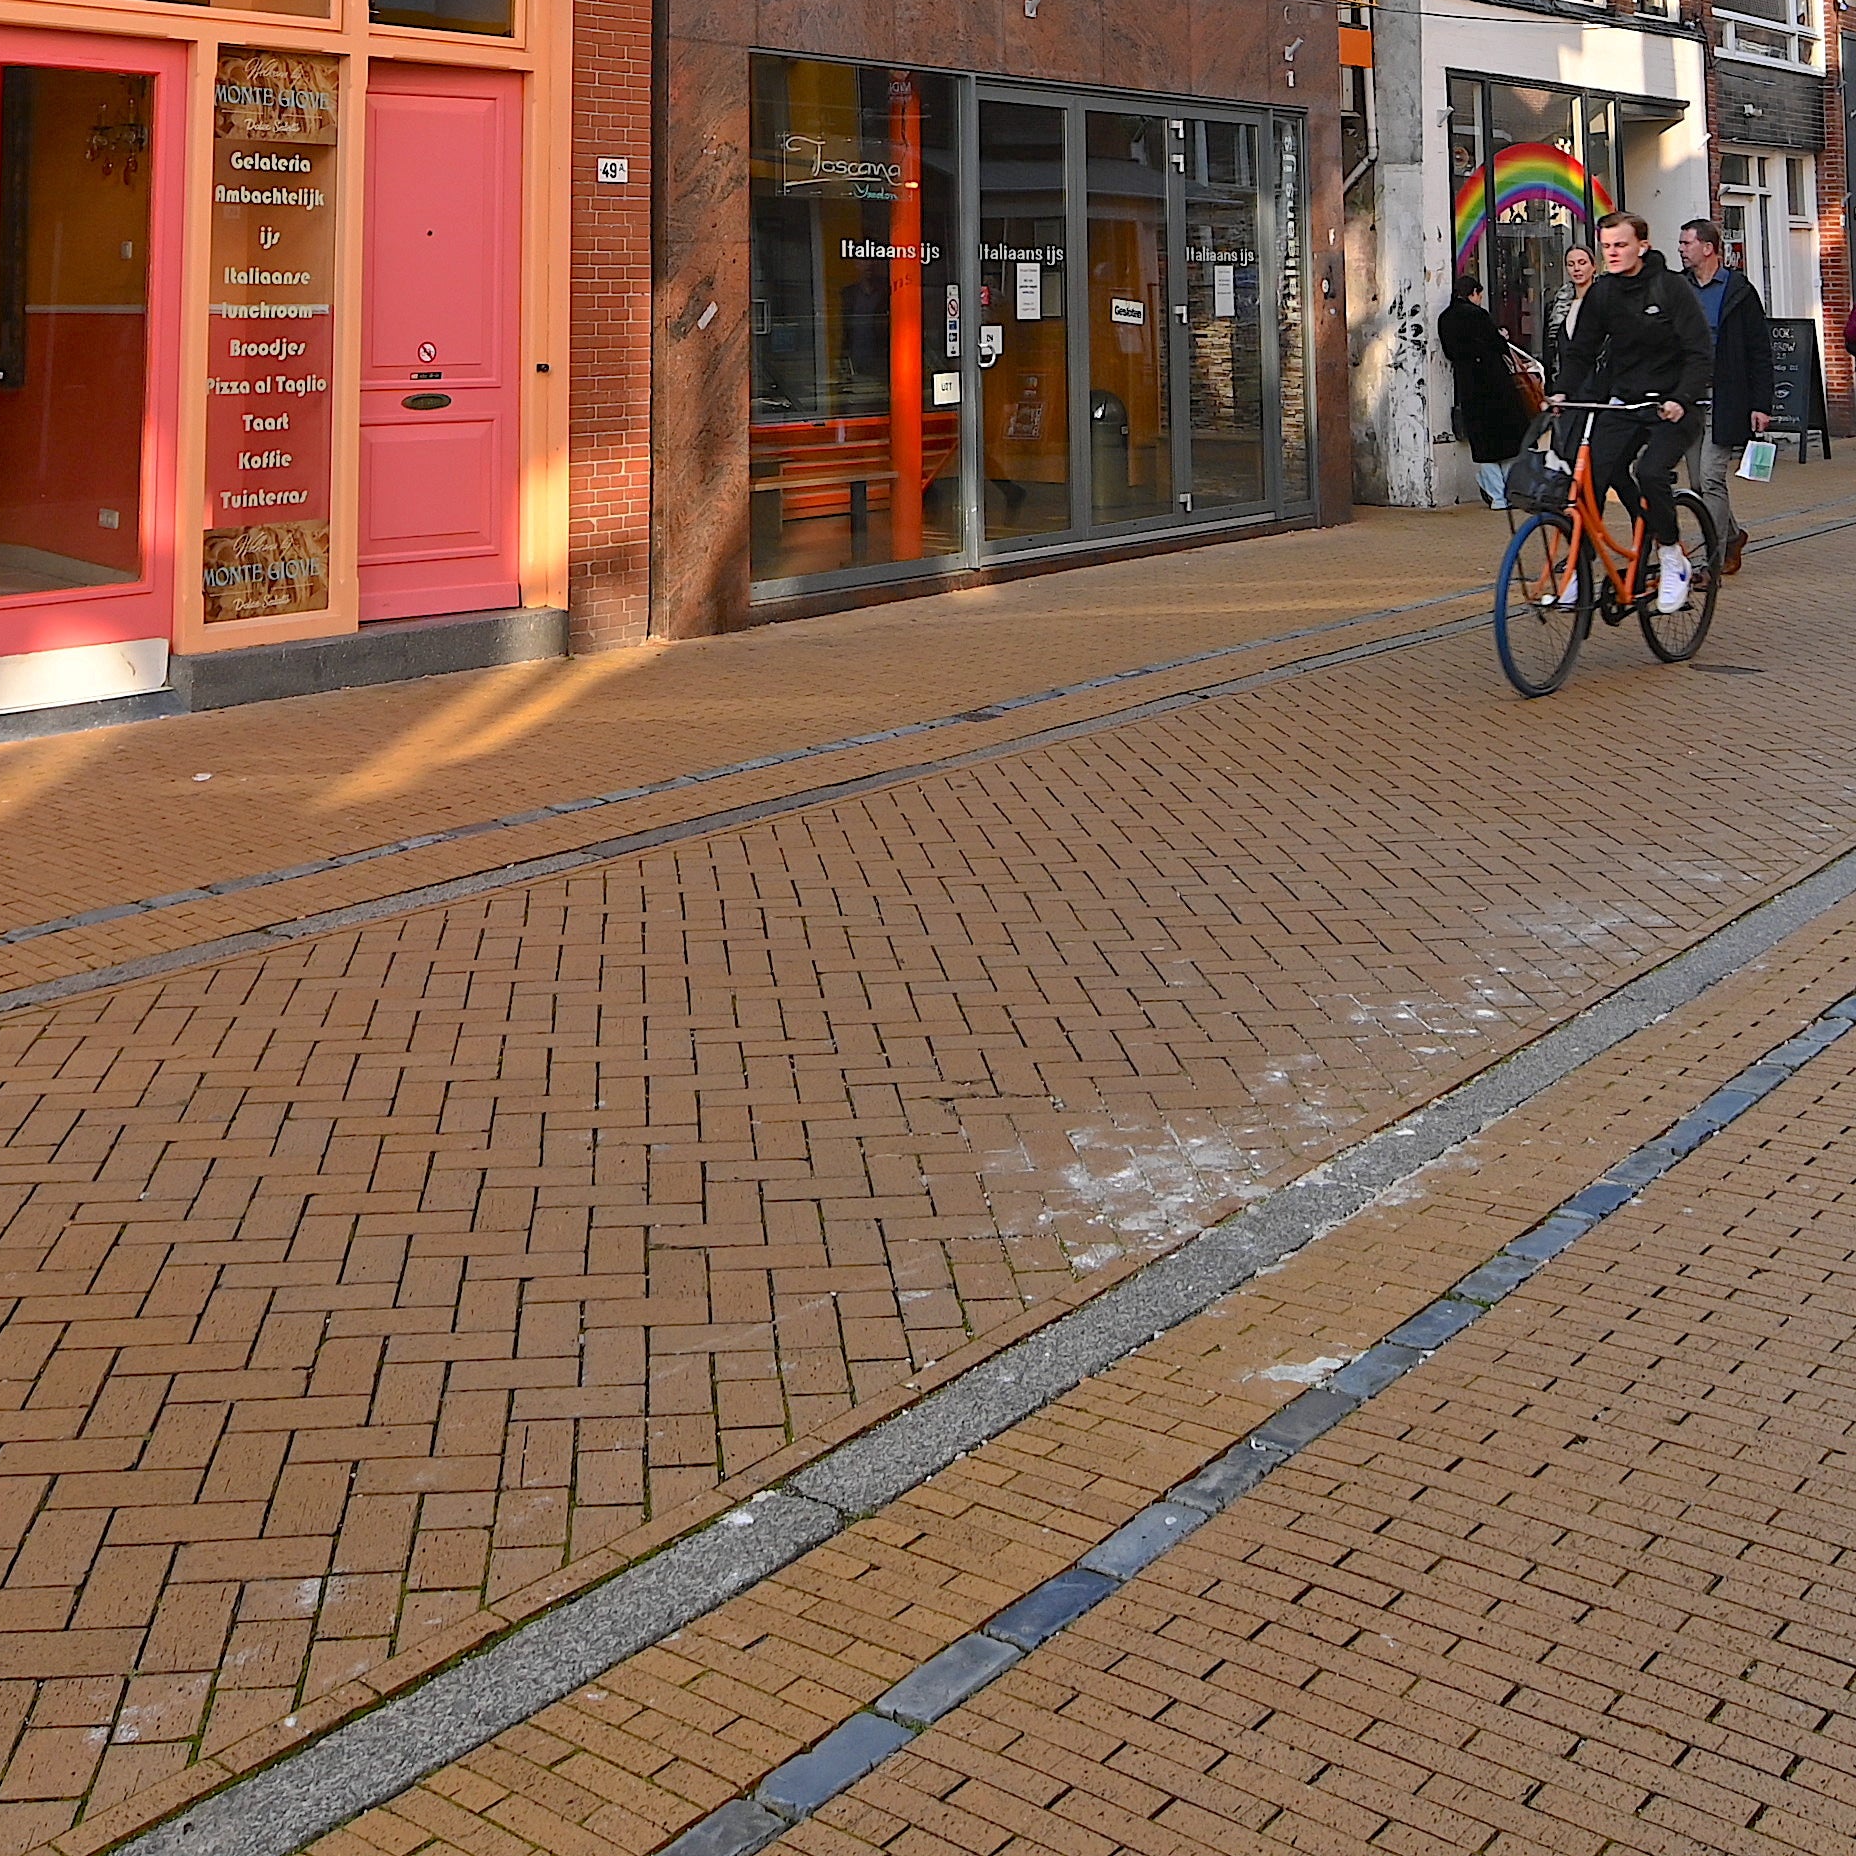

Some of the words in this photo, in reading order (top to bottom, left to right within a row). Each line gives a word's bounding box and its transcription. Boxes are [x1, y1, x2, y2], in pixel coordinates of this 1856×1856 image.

[214, 84, 275, 107] MONTE
[278, 89, 330, 111] GIOVE
[230, 151, 312, 174] Gelateria
[214, 185, 326, 212] Ambachtelijk
[259, 226, 281, 251] ijs
[841, 239, 917, 259] Italiaans
[920, 242, 941, 265] ijs
[978, 242, 1044, 261] Italiaans
[1046, 244, 1065, 266] ijs
[1185, 245, 1238, 262] Italiaans
[1240, 246, 1255, 266] ijs
[223, 268, 312, 287] Italiaanse
[221, 301, 313, 321] lunchroom
[229, 337, 307, 361] Broodjes
[205, 377, 251, 396] Pizza
[254, 375, 272, 394] al
[275, 373, 328, 397] Taglio
[242, 413, 290, 433] Taart
[237, 450, 292, 471] Koffie
[220, 488, 308, 510] Tuinterras
[204, 563, 264, 587] MONTE
[267, 557, 321, 581] GIOVE
